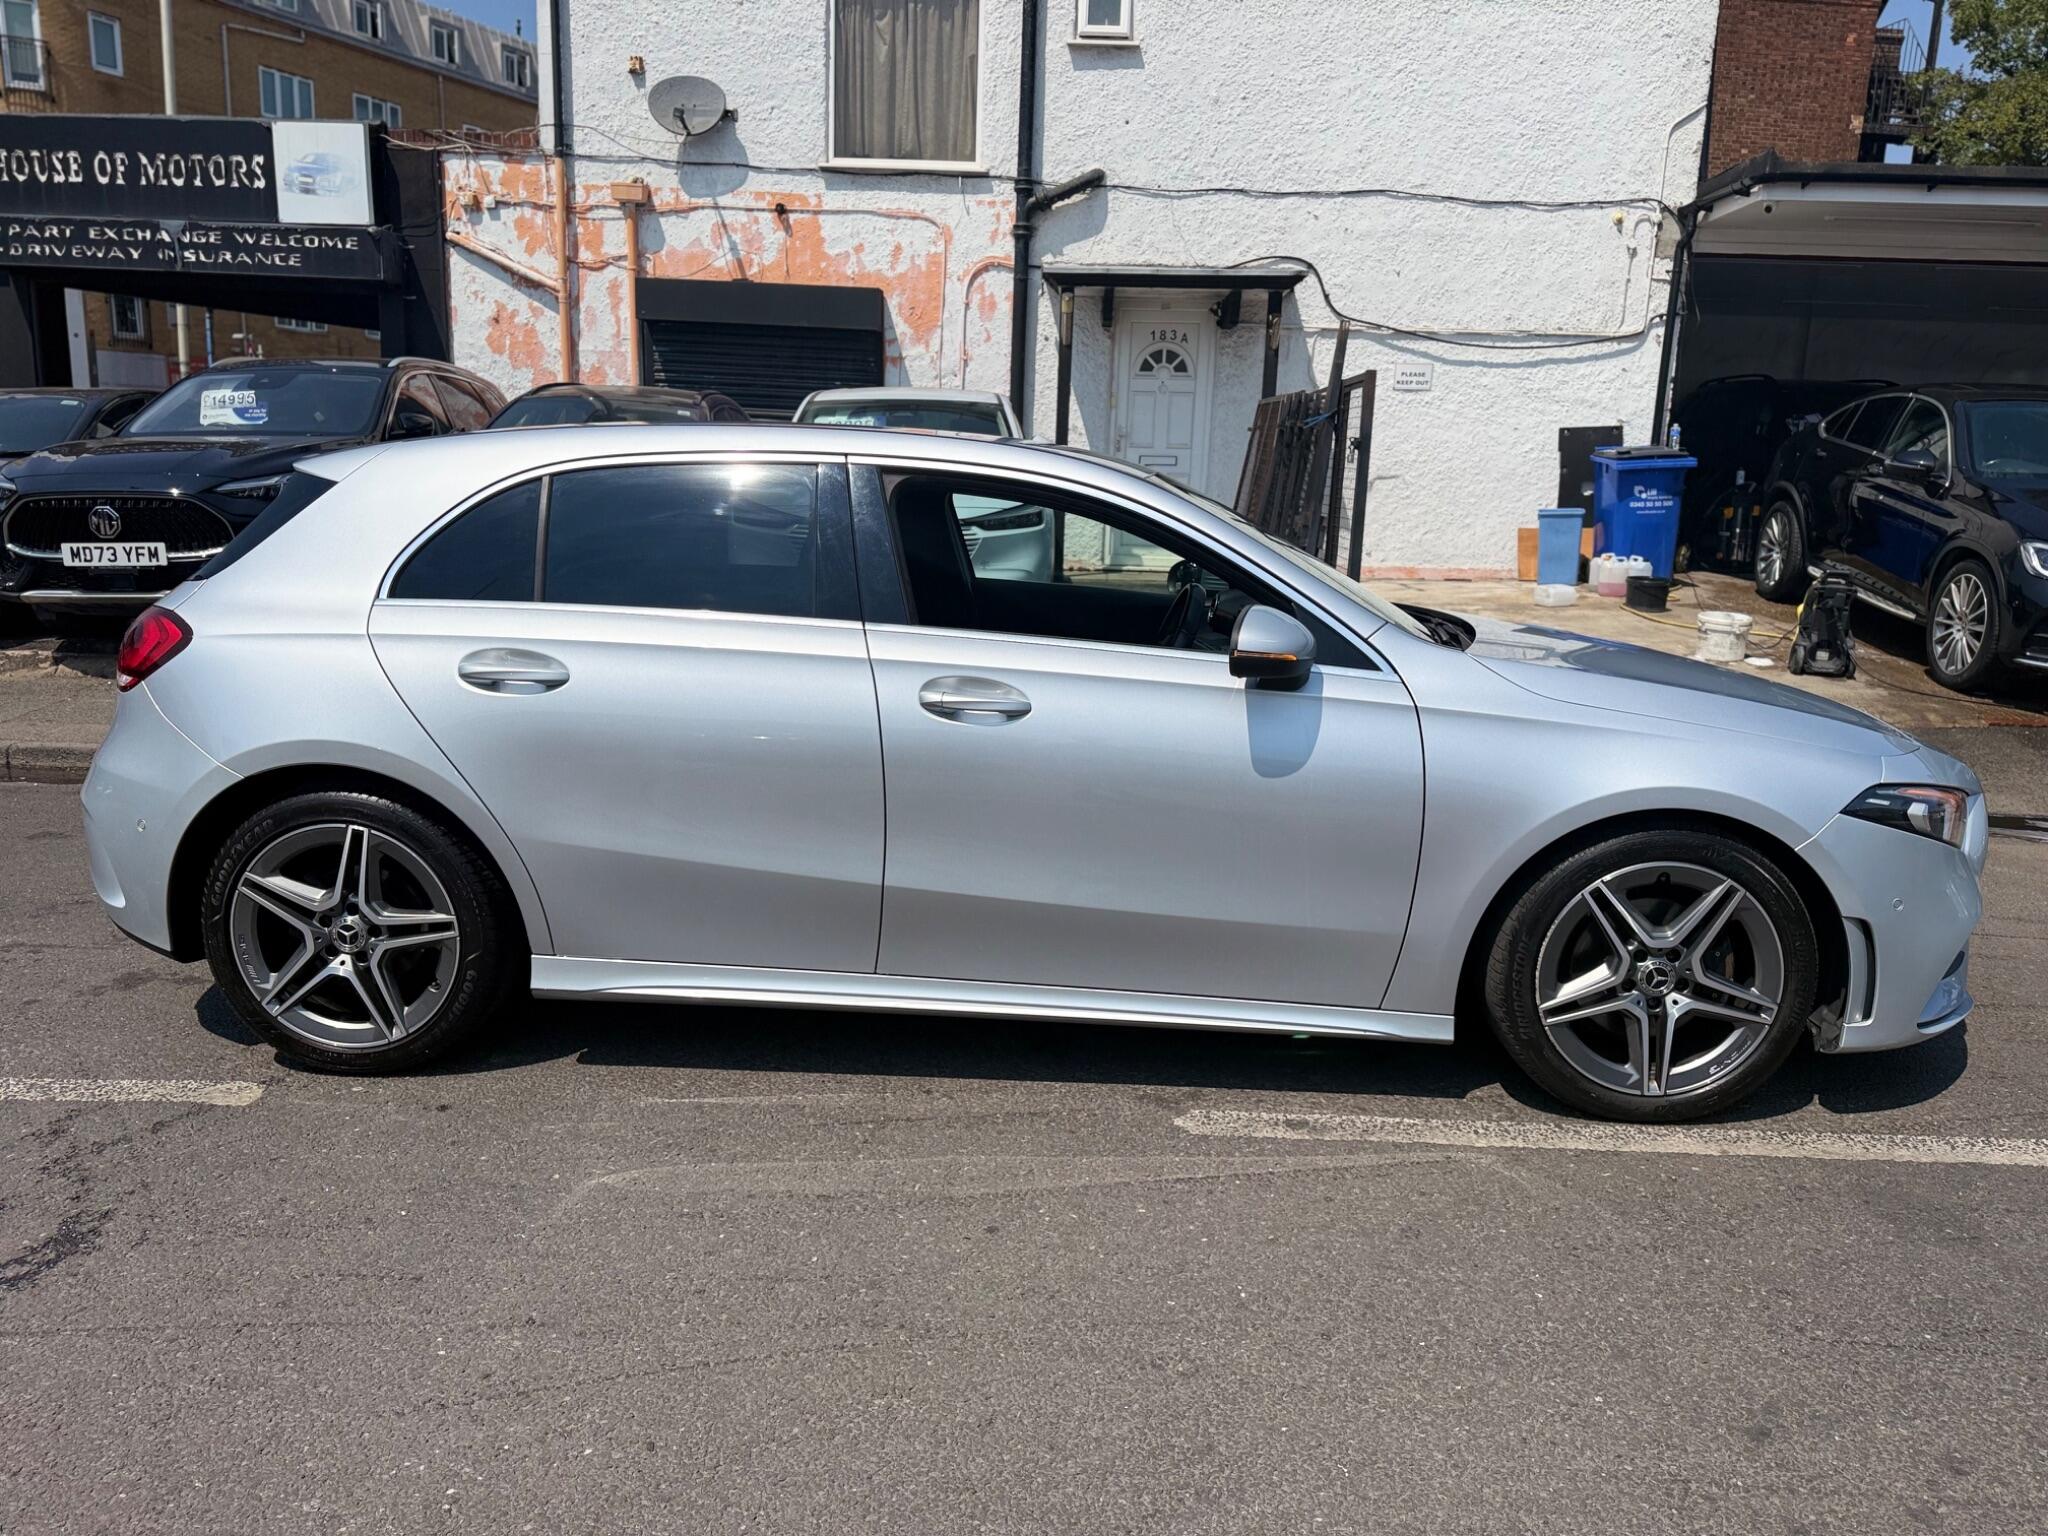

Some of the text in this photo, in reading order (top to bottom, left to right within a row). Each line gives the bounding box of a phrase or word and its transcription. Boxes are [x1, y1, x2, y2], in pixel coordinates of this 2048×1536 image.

[93, 150, 128, 185] OF
[136, 151, 266, 189] MOTORS
[8, 224, 74, 238] PART
[232, 232, 359, 250] WELCOME
[9, 243, 143, 260] DRIVEWAY
[69, 545, 160, 563] MD73 YFM
[211, 818, 274, 906] GOODYEAR
